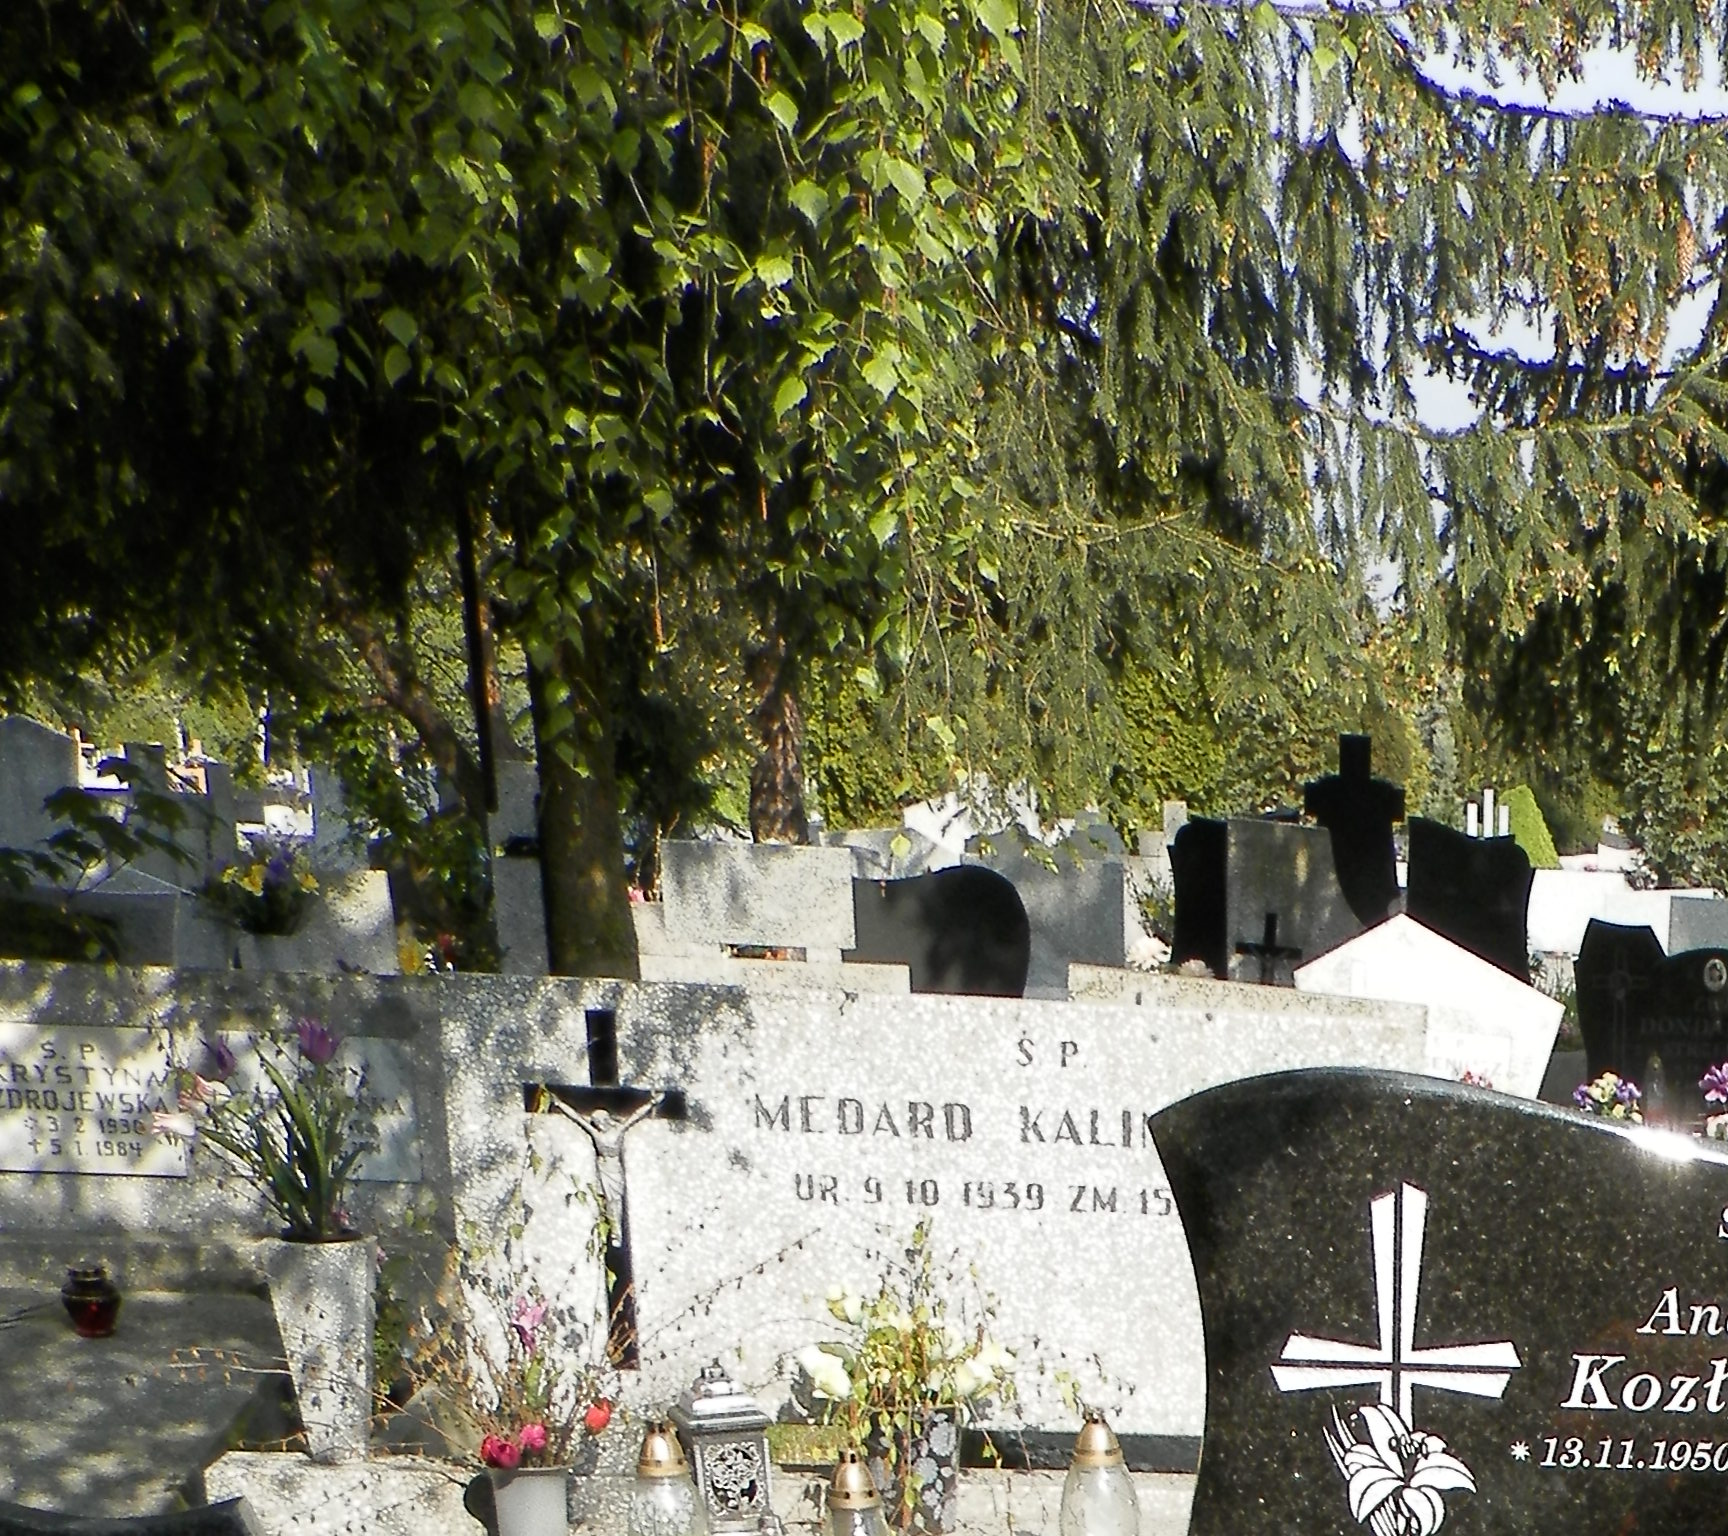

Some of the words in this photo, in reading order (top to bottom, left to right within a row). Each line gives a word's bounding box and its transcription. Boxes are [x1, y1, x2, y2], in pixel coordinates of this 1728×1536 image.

[0, 1086, 169, 1115] DROJEWSKA
[753, 1092, 974, 1143] MEDARD
[1018, 1105, 1149, 1149] KALI
